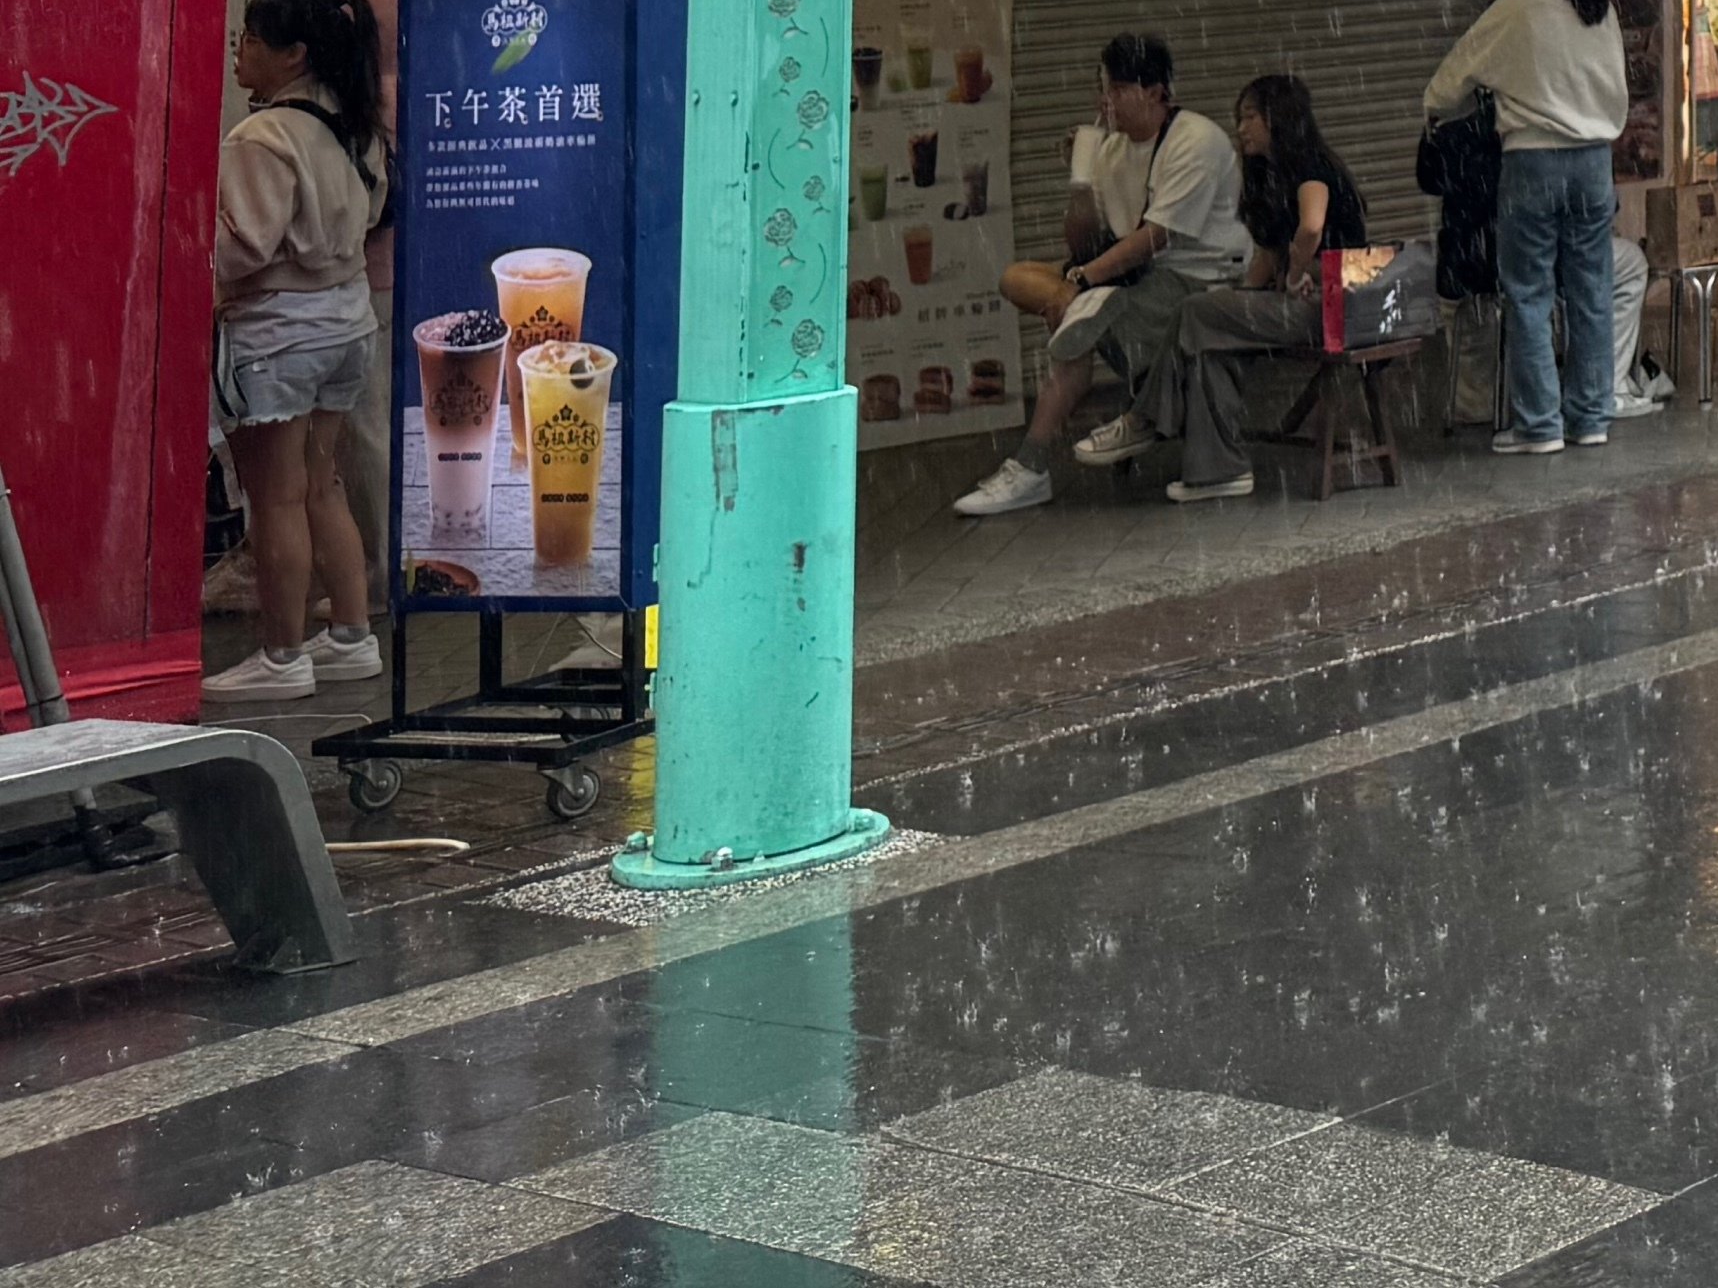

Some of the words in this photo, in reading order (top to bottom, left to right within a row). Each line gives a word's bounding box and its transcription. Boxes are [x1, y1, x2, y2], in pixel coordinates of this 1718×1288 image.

[425, 83, 603, 128] 下午茶首選
[536, 428, 596, 448] 馬祖新村
